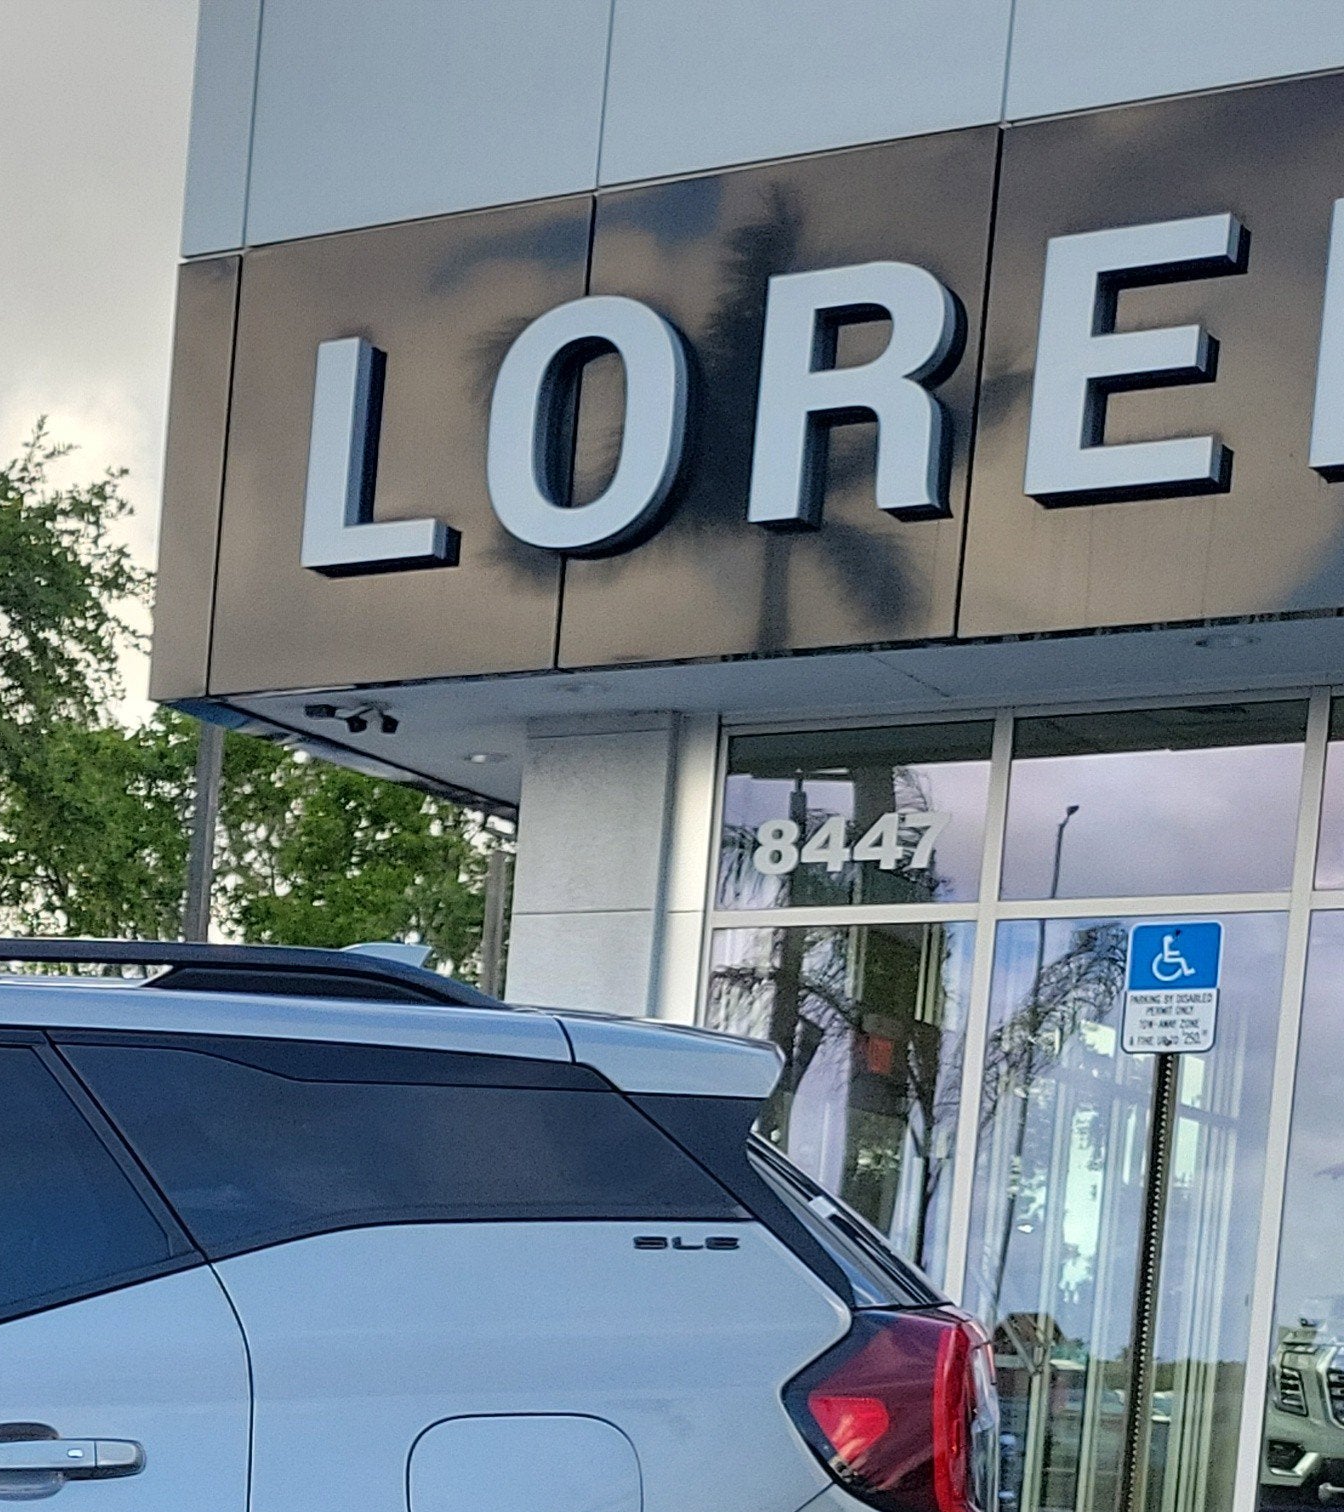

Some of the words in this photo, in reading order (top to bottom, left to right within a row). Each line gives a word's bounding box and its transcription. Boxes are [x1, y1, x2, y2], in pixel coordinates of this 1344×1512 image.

[301, 197, 1344, 576] LORE
[752, 811, 951, 875] 8447
[633, 1235, 740, 1250] SLE
